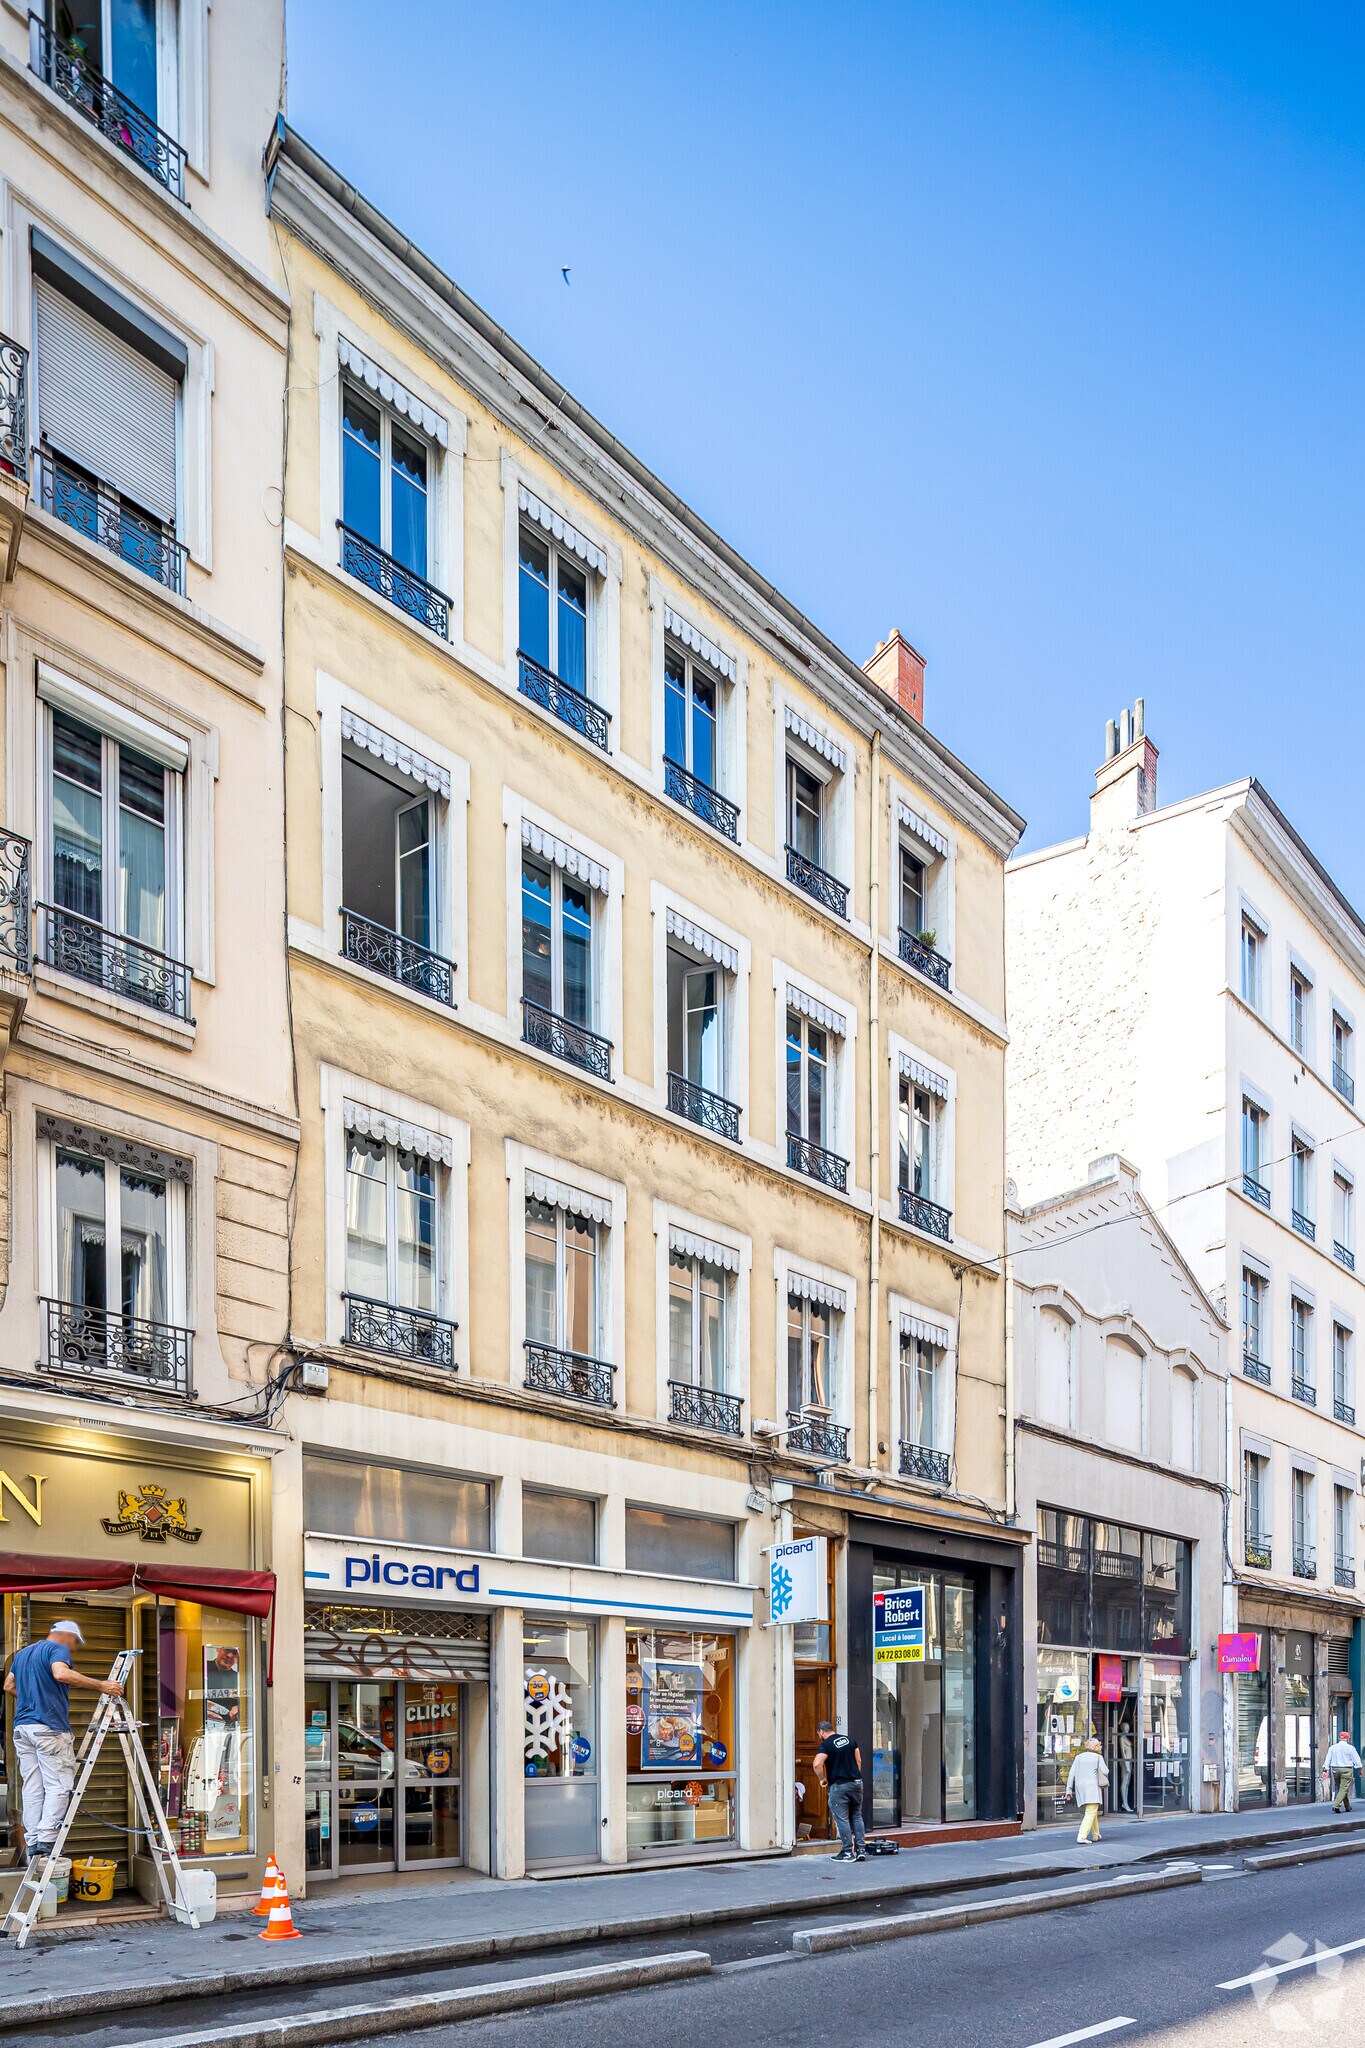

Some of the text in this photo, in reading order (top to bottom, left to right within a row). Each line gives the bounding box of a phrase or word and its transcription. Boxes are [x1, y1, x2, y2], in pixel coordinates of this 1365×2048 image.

[107, 1522, 144, 1533] TRADITION
[776, 1540, 813, 1559] picard
[345, 1554, 480, 1593] picard
[885, 1597, 912, 1610] Brice
[885, 1609, 920, 1623] Robert
[877, 1649, 920, 1660] 04 72 83 08 08
[406, 1702, 457, 1721] CLICK &
[406, 1718, 457, 1735] COLLECT
[657, 1788, 693, 1800] picard
